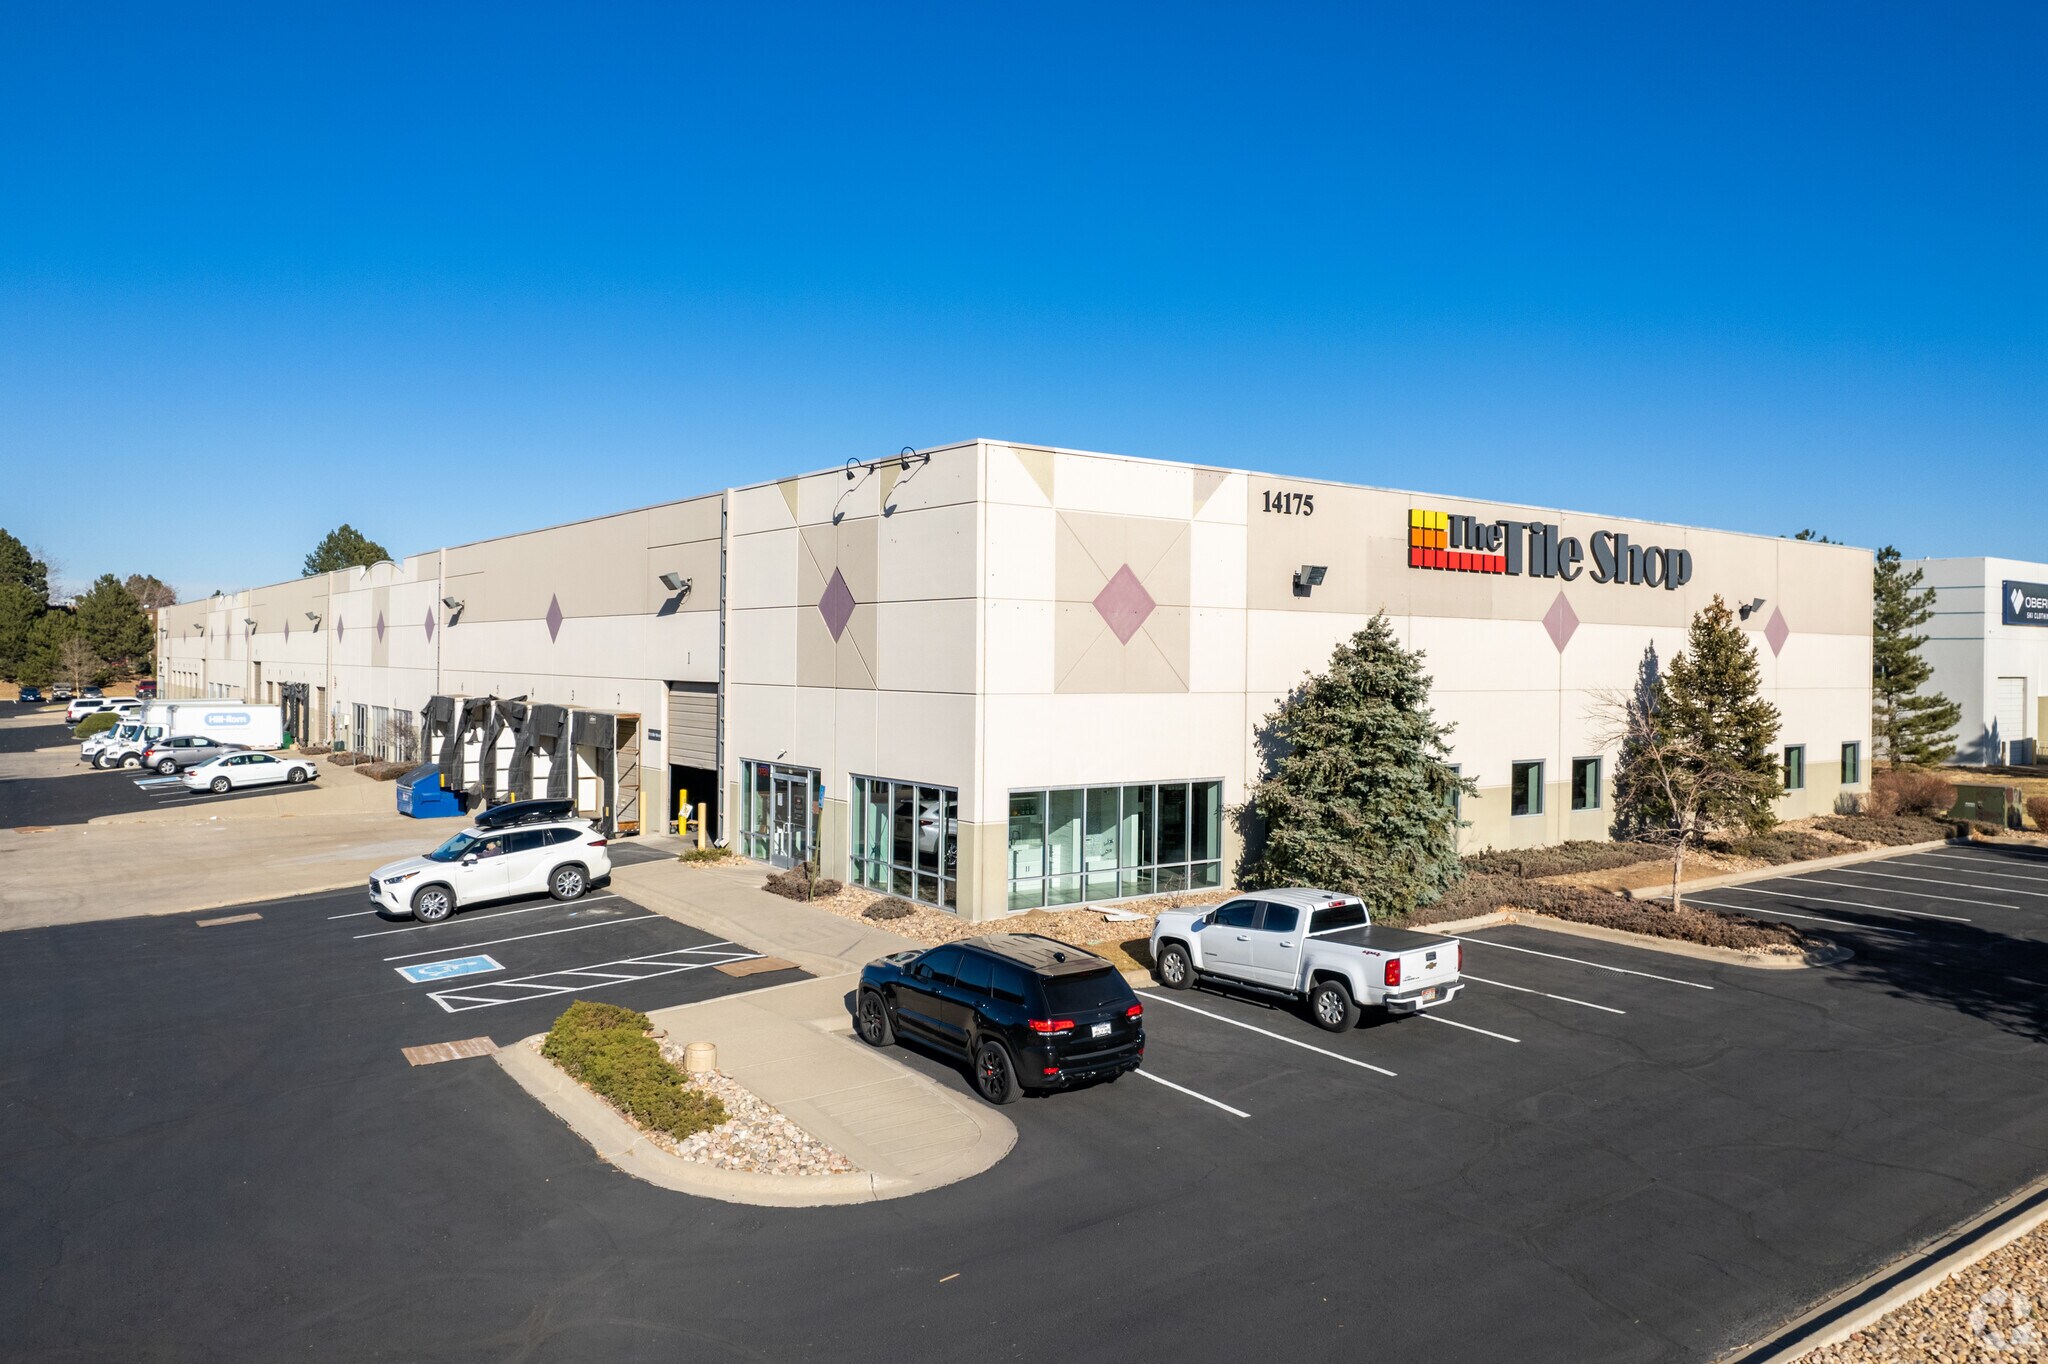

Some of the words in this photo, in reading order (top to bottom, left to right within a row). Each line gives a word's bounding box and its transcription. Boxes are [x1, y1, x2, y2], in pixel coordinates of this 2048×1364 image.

[1262, 490, 1314, 516] 14175
[1447, 514, 1503, 552] The
[1496, 520, 1584, 581] Tile
[1589, 530, 1692, 590] Shop
[2025, 596, 2048, 609] OBER
